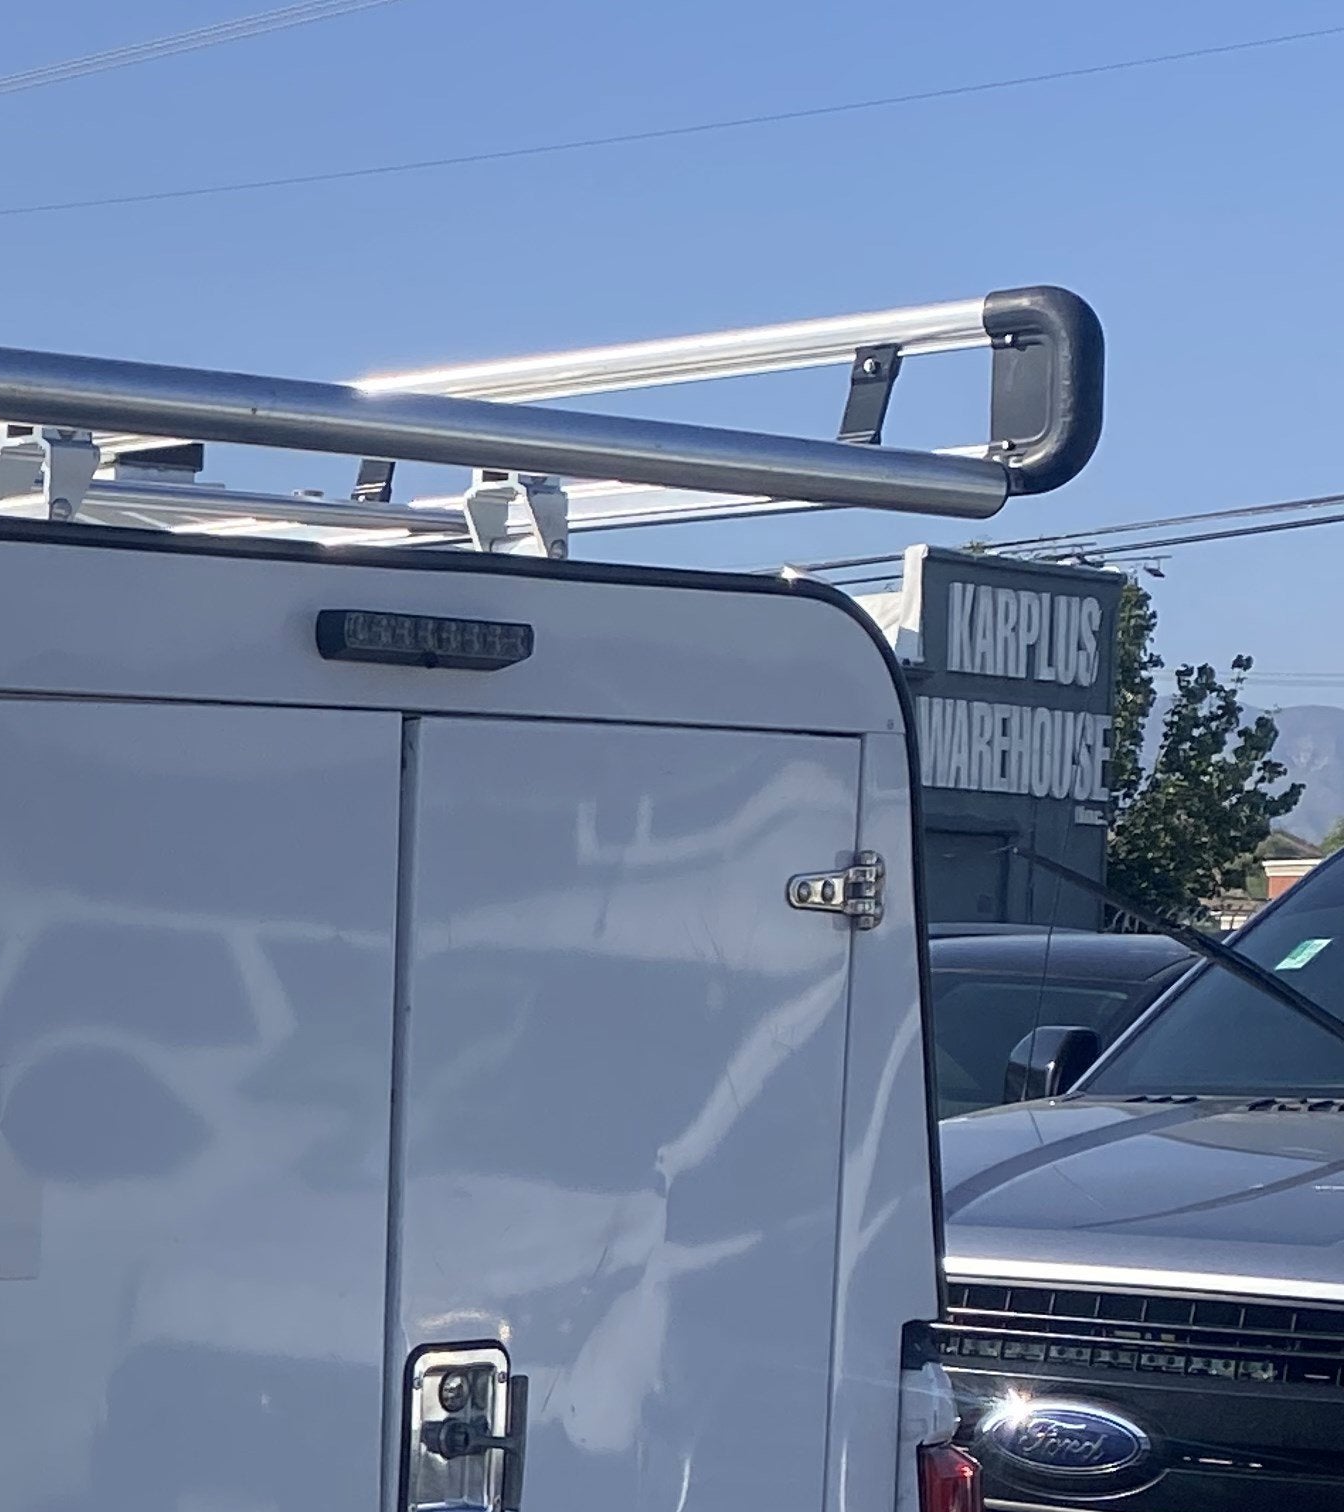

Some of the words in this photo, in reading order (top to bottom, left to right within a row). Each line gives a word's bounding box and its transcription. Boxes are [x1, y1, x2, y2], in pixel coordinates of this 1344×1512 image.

[947, 582, 1102, 688] KARPLUS
[916, 696, 1111, 801] WAREHOUSE
[1018, 1417, 1108, 1460] Ford
